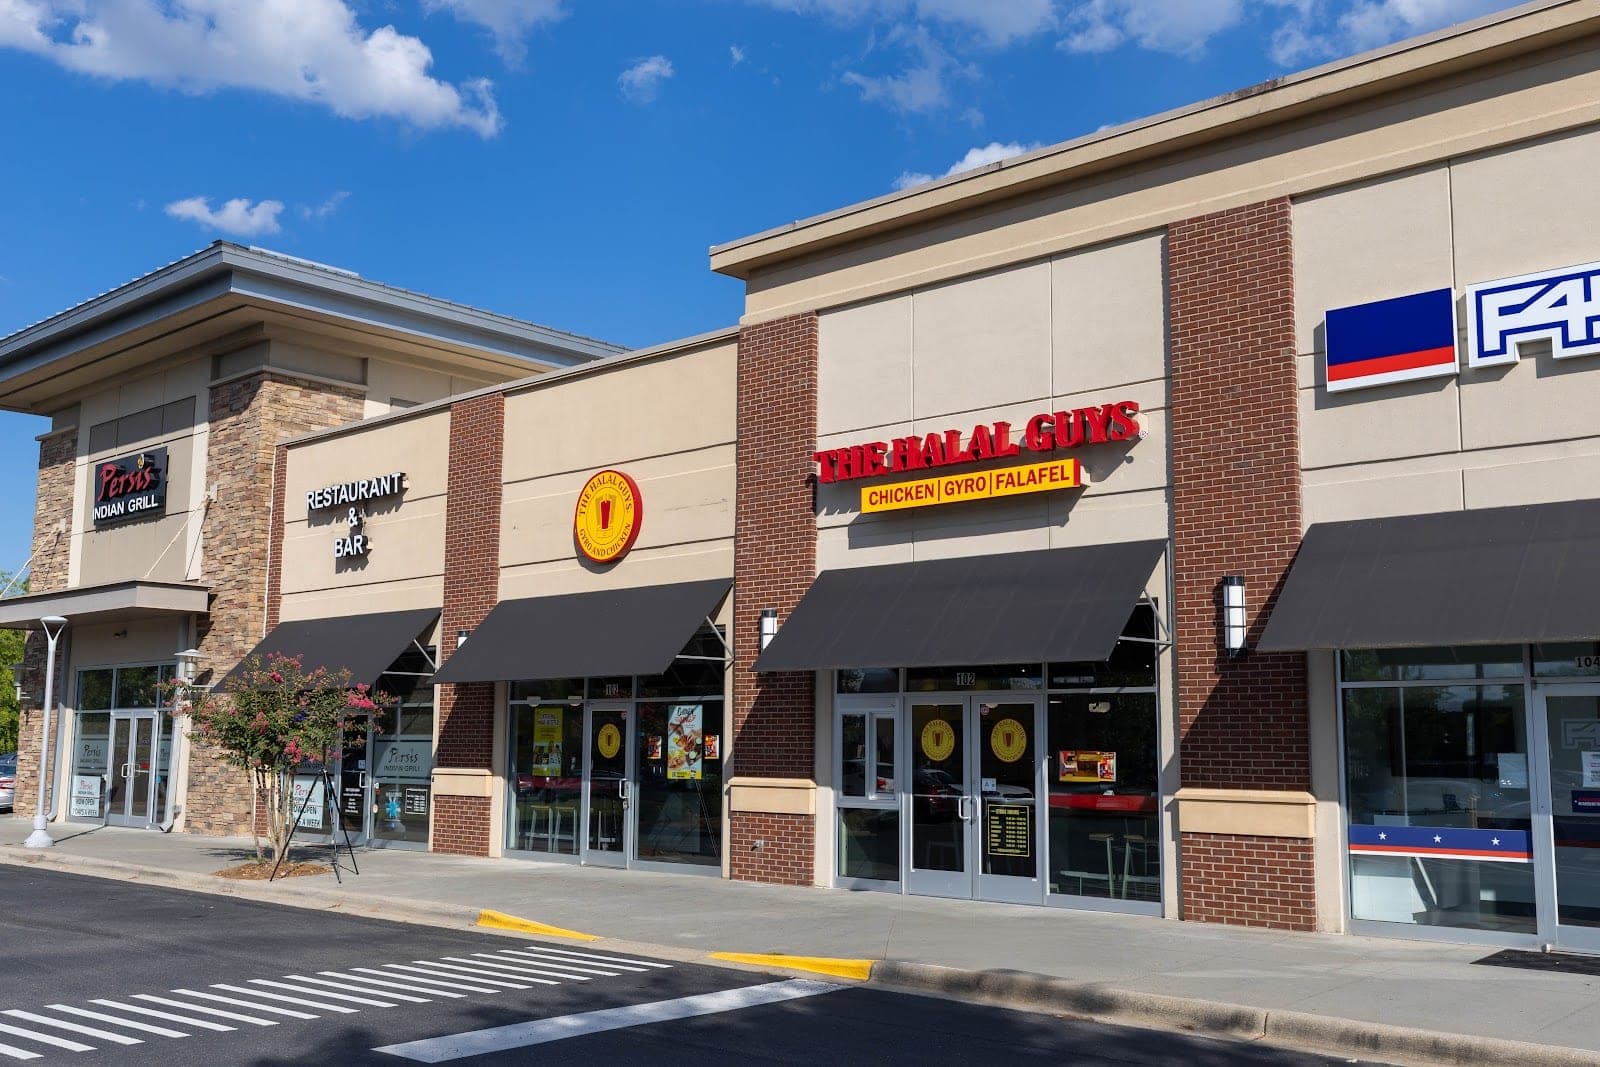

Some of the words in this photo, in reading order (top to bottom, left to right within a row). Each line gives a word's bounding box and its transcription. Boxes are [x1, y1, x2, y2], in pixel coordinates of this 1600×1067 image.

[813, 441, 889, 484] THE
[891, 421, 1021, 472] HALAL
[1025, 400, 1140, 452] GUYS
[98, 462, 152, 501] Persis
[306, 472, 401, 510] RESTAURANT
[579, 492, 592, 515] THE
[590, 474, 617, 493] HALAL
[618, 480, 633, 513] GUYS
[868, 483, 935, 506] CHICKEN
[944, 476, 986, 496] GYRO
[995, 464, 1070, 490] FALAFEL
[92, 500, 125, 520] INDIAN
[127, 494, 159, 512] GRILL
[347, 506, 358, 527] &
[334, 534, 364, 557] BAR
[1576, 656, 1600, 668] 104
[957, 672, 976, 686] 102
[388, 748, 419, 763] Persis
